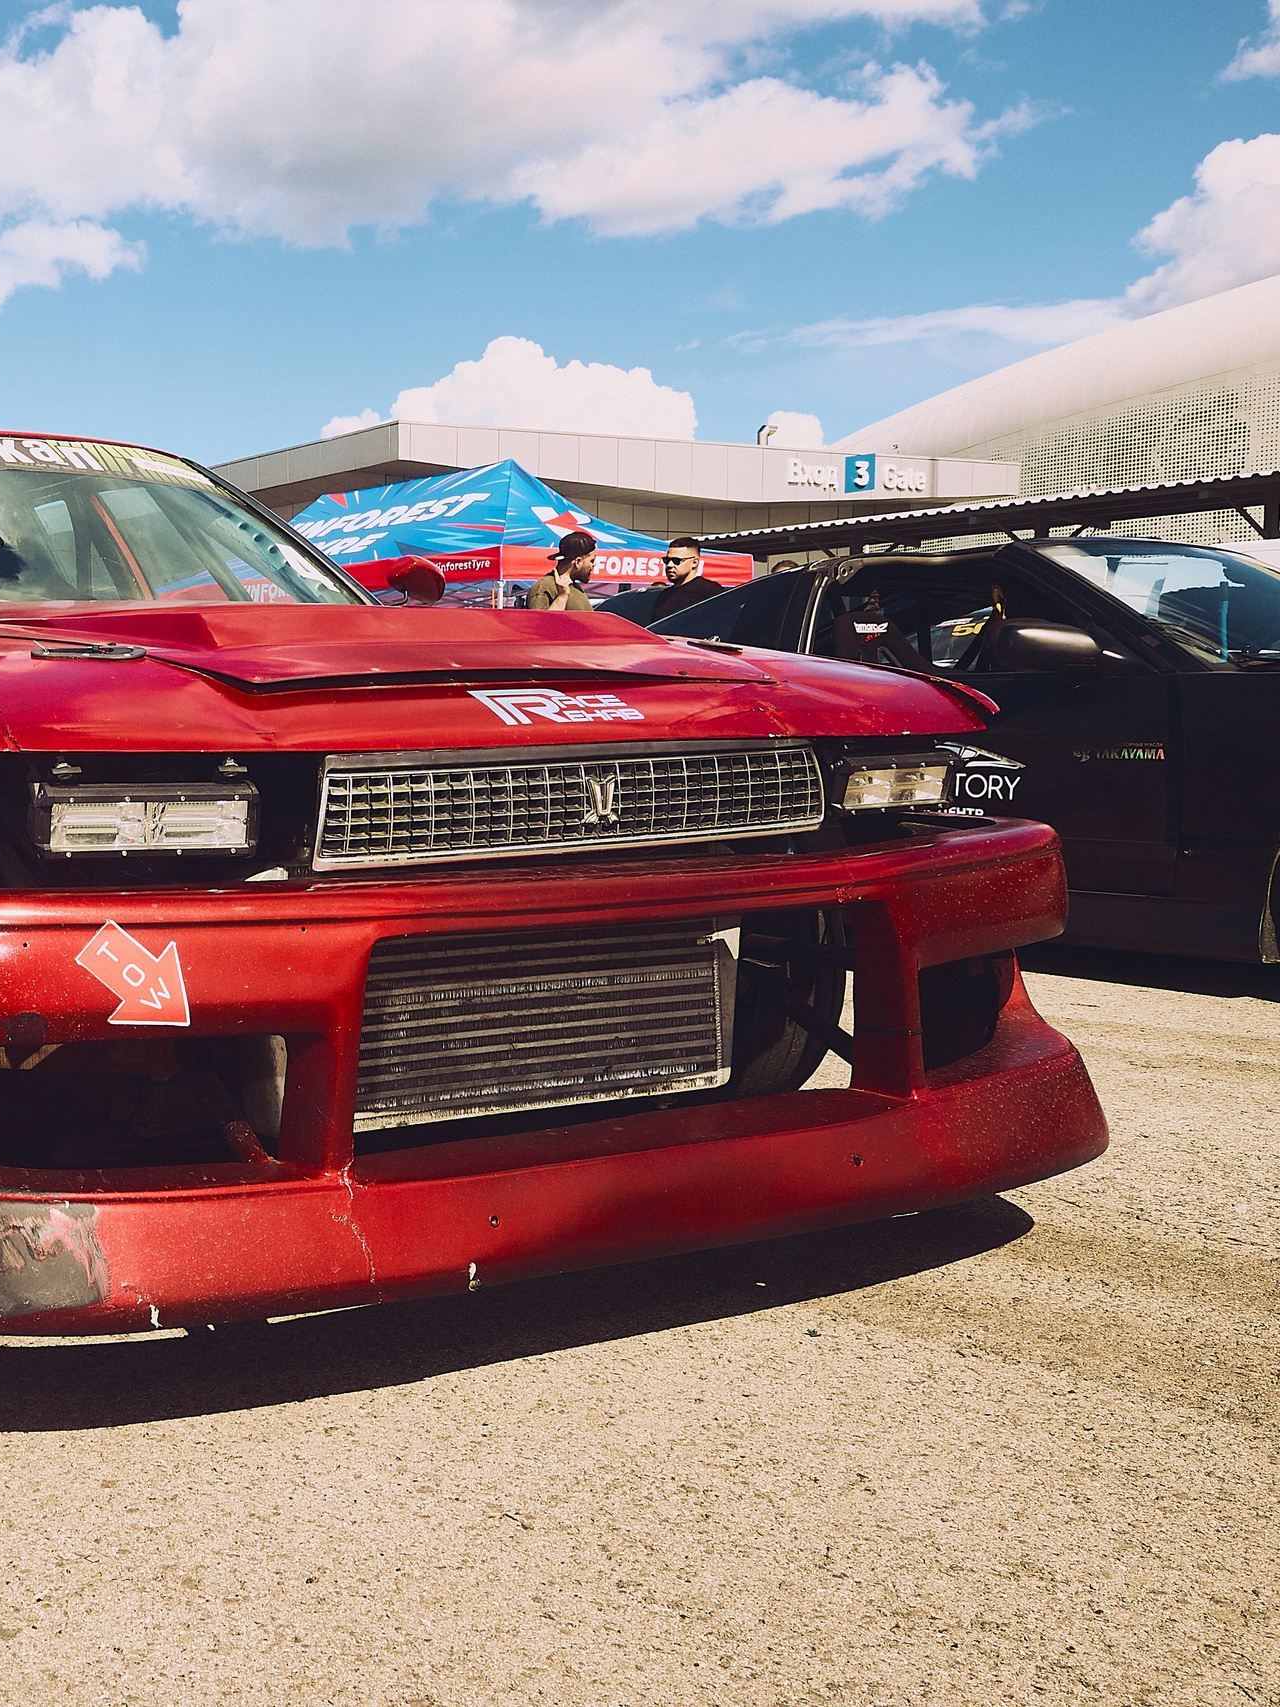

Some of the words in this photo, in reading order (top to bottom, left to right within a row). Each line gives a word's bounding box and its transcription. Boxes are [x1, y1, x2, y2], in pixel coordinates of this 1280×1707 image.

[788, 458, 839, 491] Вход
[853, 460, 870, 488] 3
[883, 463, 927, 492] Gate
[291, 492, 492, 540] INFOREST
[313, 531, 390, 556] YRE
[435, 559, 490, 571] inforestTyre
[1096, 748, 1165, 760] TAKAYAMA
[95, 940, 171, 1010] TOW
